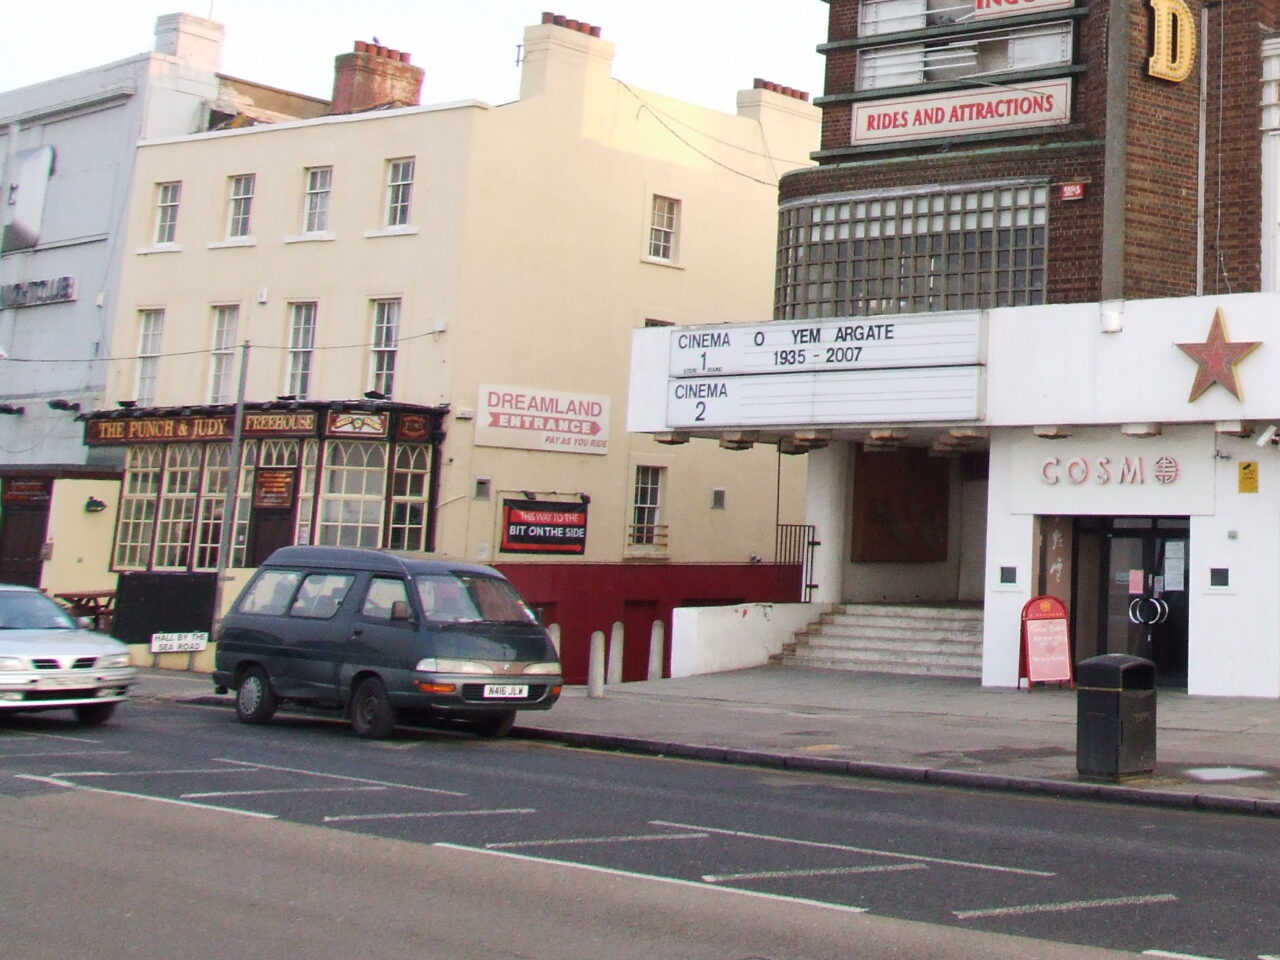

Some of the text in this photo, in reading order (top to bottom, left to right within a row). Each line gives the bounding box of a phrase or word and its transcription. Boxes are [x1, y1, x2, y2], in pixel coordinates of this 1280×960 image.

[867, 94, 1055, 131] RIDES AND ATTRACTIONS
[678, 332, 731, 349] CINEMA
[754, 331, 765, 347] O
[834, 324, 895, 342] ARGATE
[701, 351, 707, 371] 1
[774, 349, 806, 366] 1935
[825, 347, 863, 363] 2007
[674, 383, 728, 399] CINEMA
[487, 391, 603, 417] DREAMLAND
[694, 401, 706, 422] 2
[99, 418, 227, 438] THE PUNCH & JUDY
[245, 414, 315, 430] FREEHOUSE
[498, 414, 592, 434] ENTRANCE
[544, 436, 608, 448] PAY AS YOU RIDE
[520, 511, 579, 522] THIS WAY TO THE
[509, 525, 585, 538] BIT ON THE SIDE
